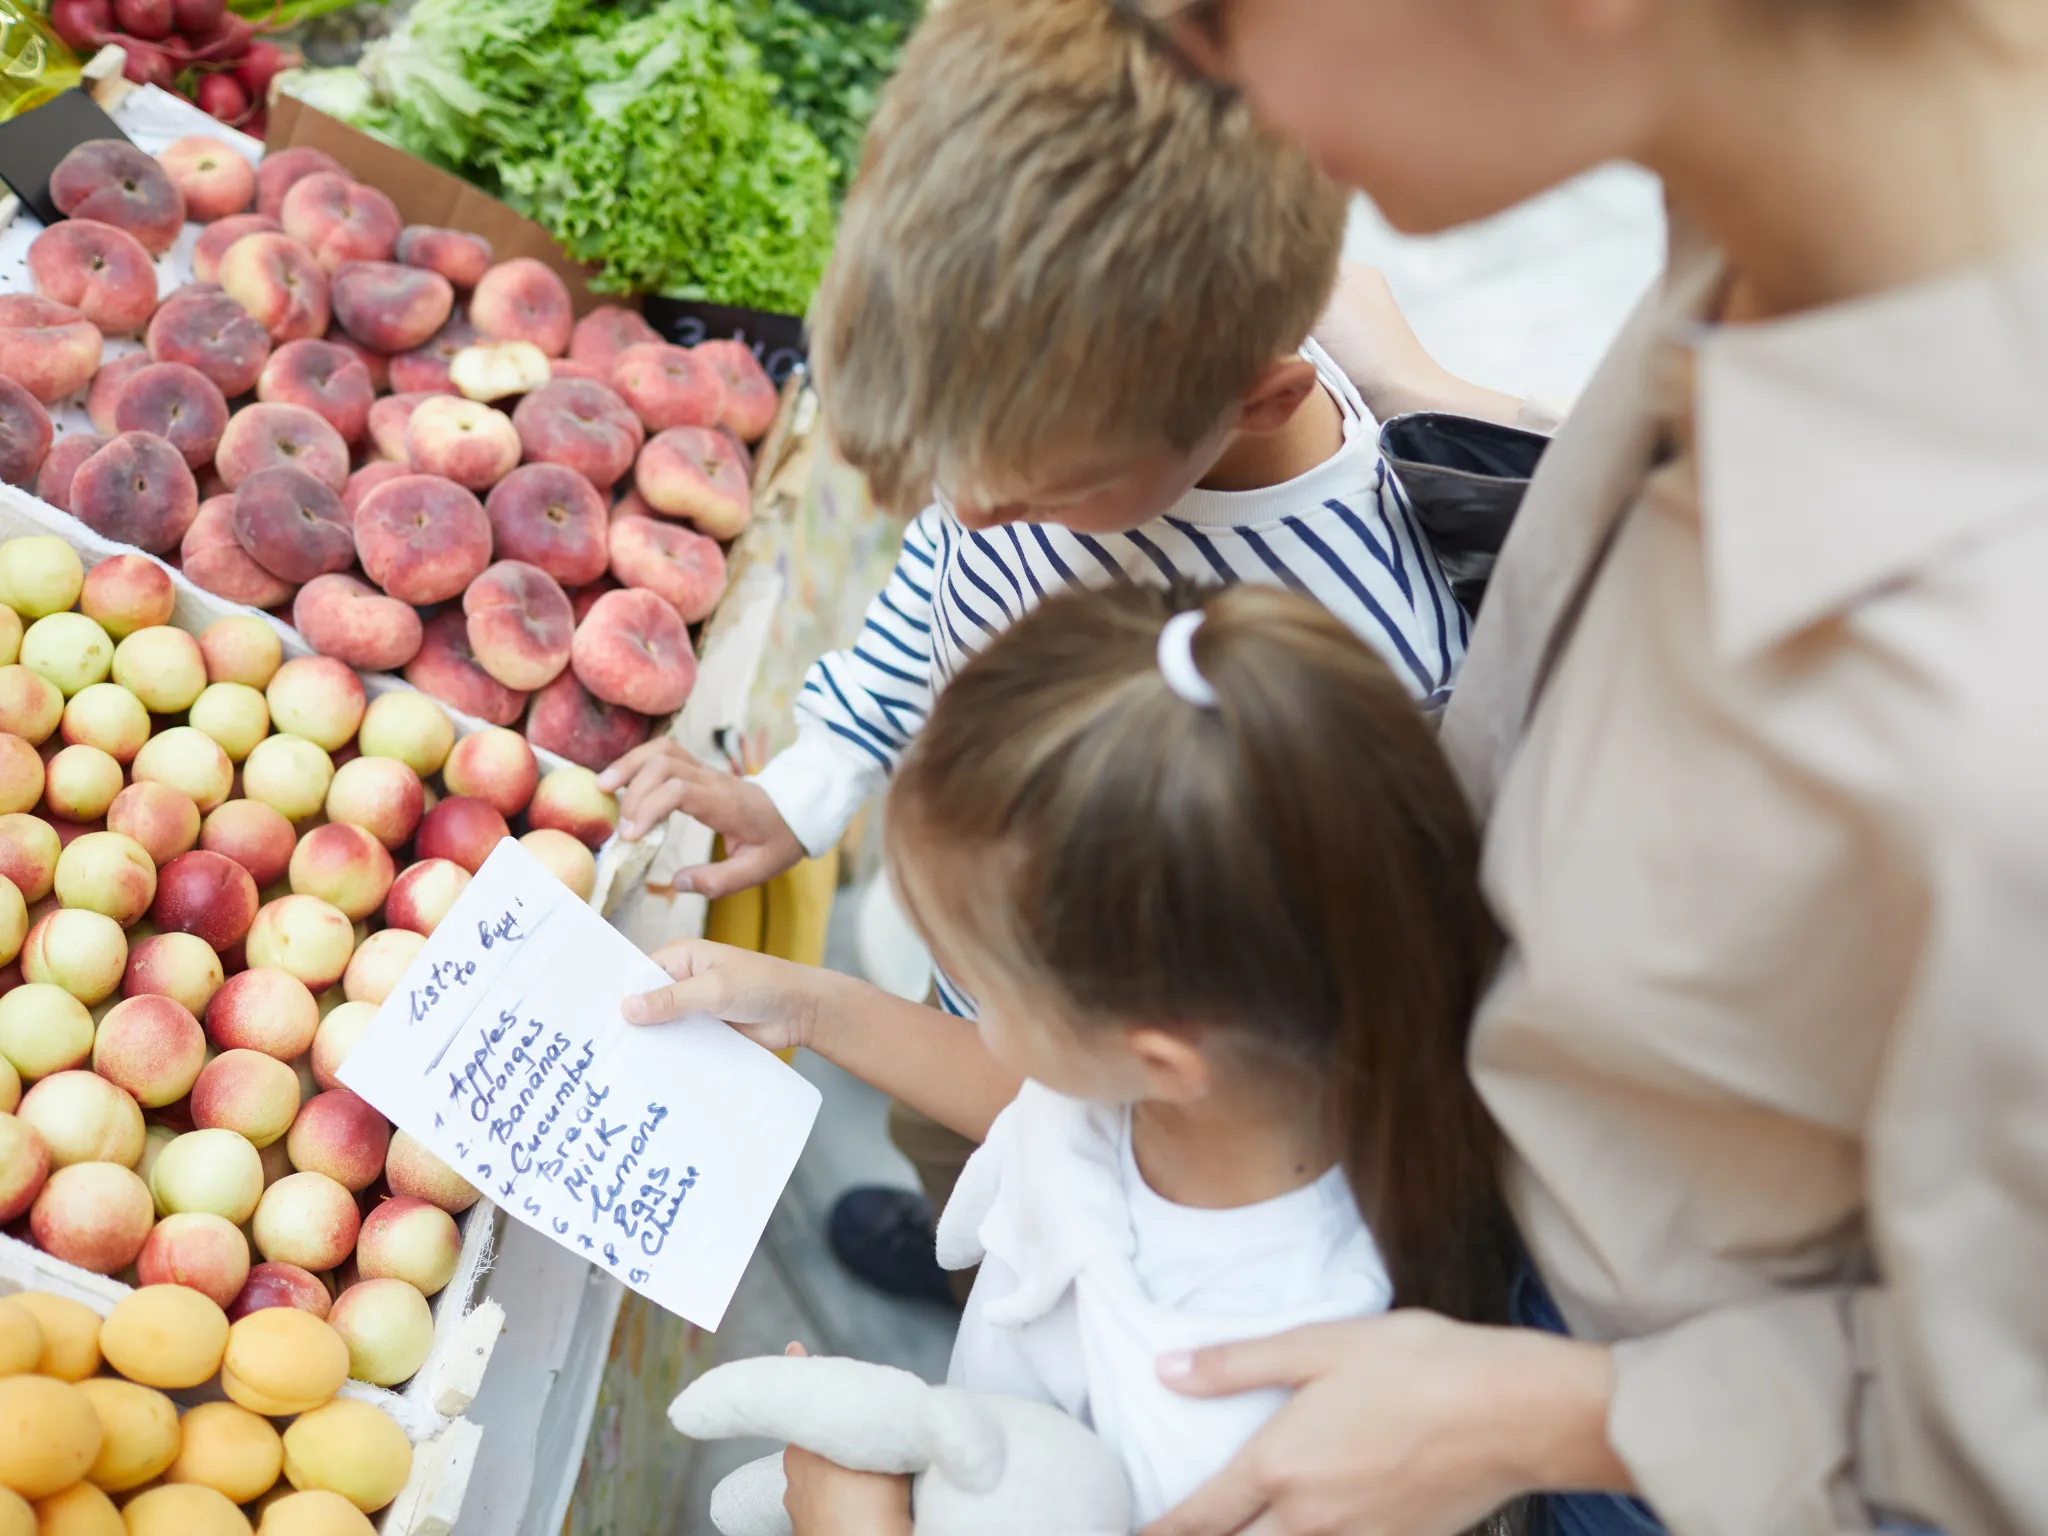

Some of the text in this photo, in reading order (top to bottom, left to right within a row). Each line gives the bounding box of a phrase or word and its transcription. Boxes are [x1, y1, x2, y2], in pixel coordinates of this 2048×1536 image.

[453, 961, 476, 985] to
[449, 1010, 517, 1104] Apples
[471, 1019, 543, 1121] Oranges
[489, 1032, 571, 1144] Bananas
[511, 1039, 594, 1173] Cucumber
[523, 1081, 609, 1216] 5 Bread
[553, 1217, 569, 1234] 6
[614, 1167, 670, 1237] Eggs
